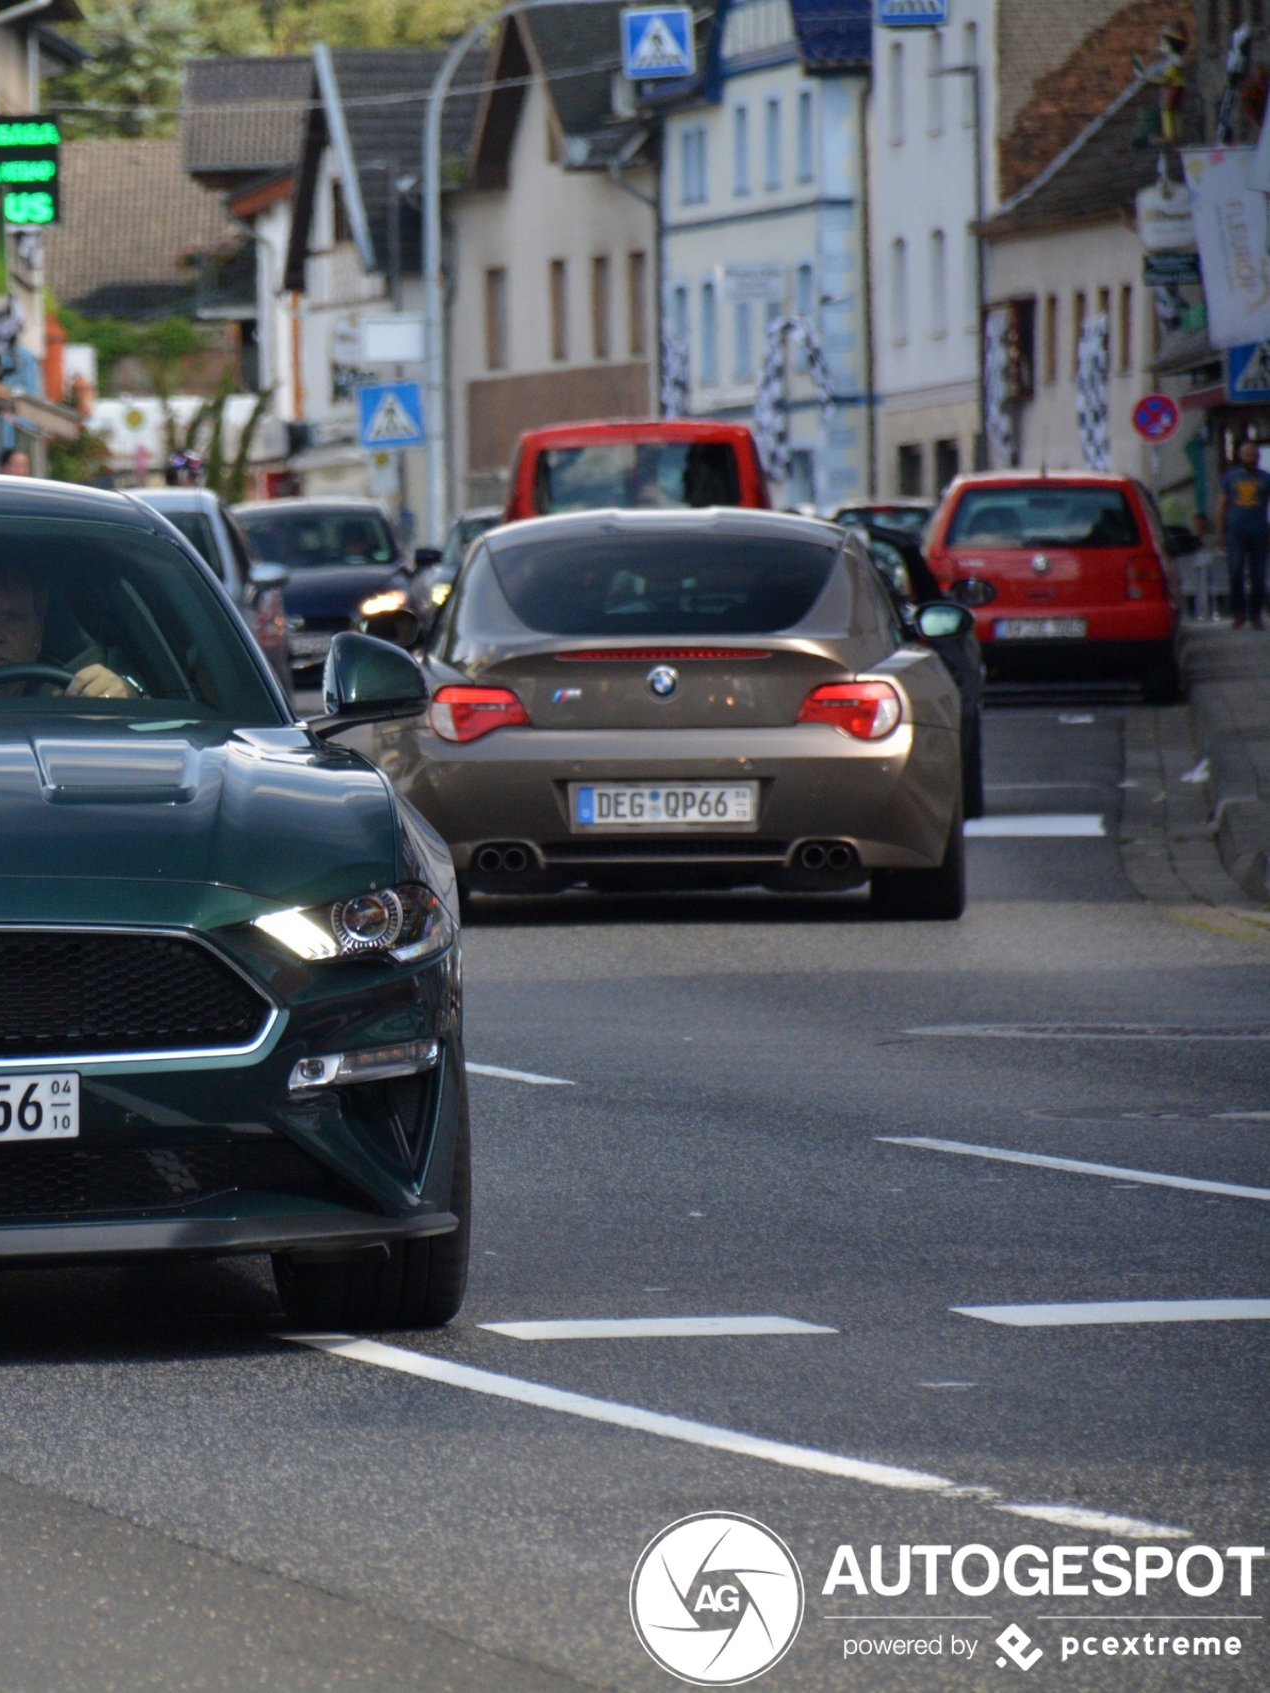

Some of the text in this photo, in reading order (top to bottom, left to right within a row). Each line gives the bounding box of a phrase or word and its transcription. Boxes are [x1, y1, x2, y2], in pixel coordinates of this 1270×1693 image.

[596, 792, 645, 818] DEG
[51, 1080, 72, 1095] 04
[52, 1115, 72, 1129] 10
